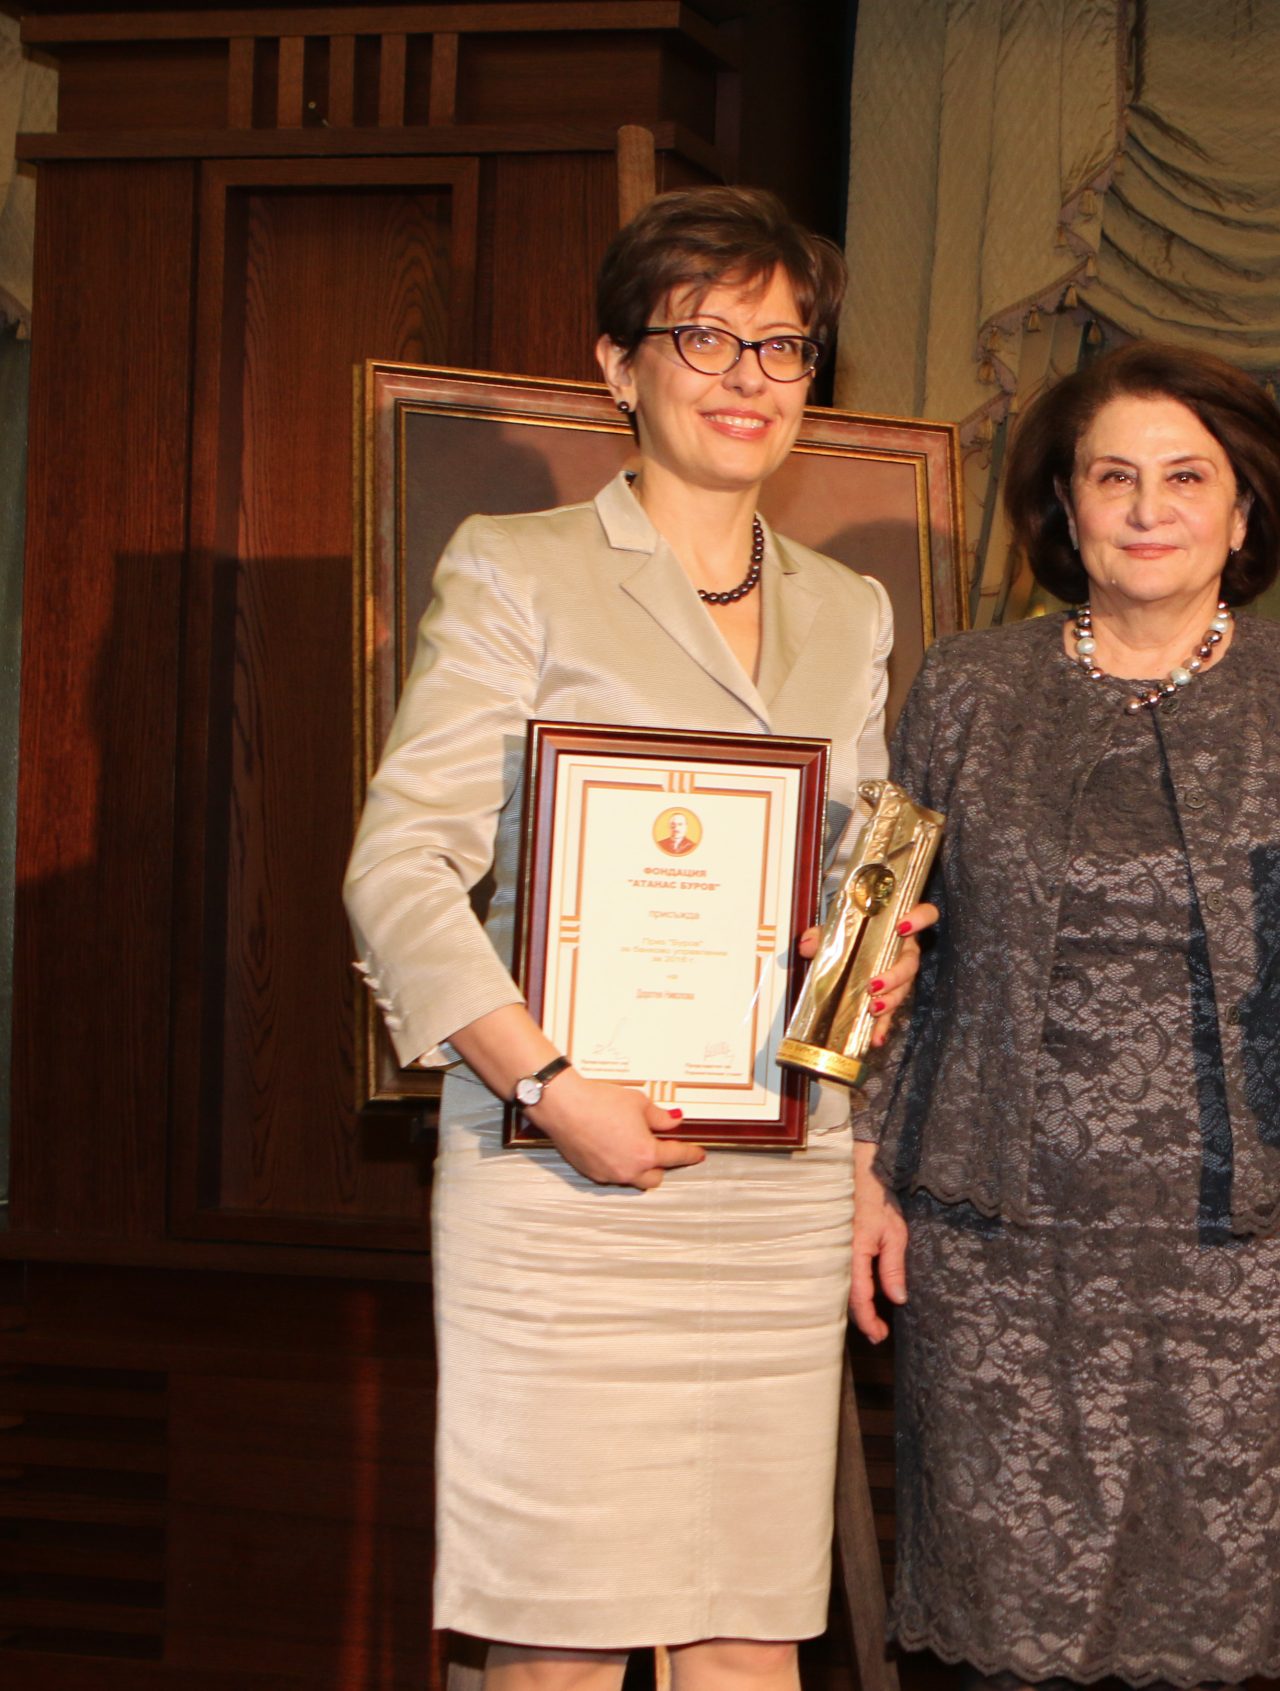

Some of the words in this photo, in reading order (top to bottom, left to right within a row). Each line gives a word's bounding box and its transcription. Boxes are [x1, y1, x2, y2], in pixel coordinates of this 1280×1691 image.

[643, 867, 706, 877] ФОНДАЦИЯ
[627, 879, 677, 889] "АТАНАС
[680, 881, 720, 891] БУРОВ"
